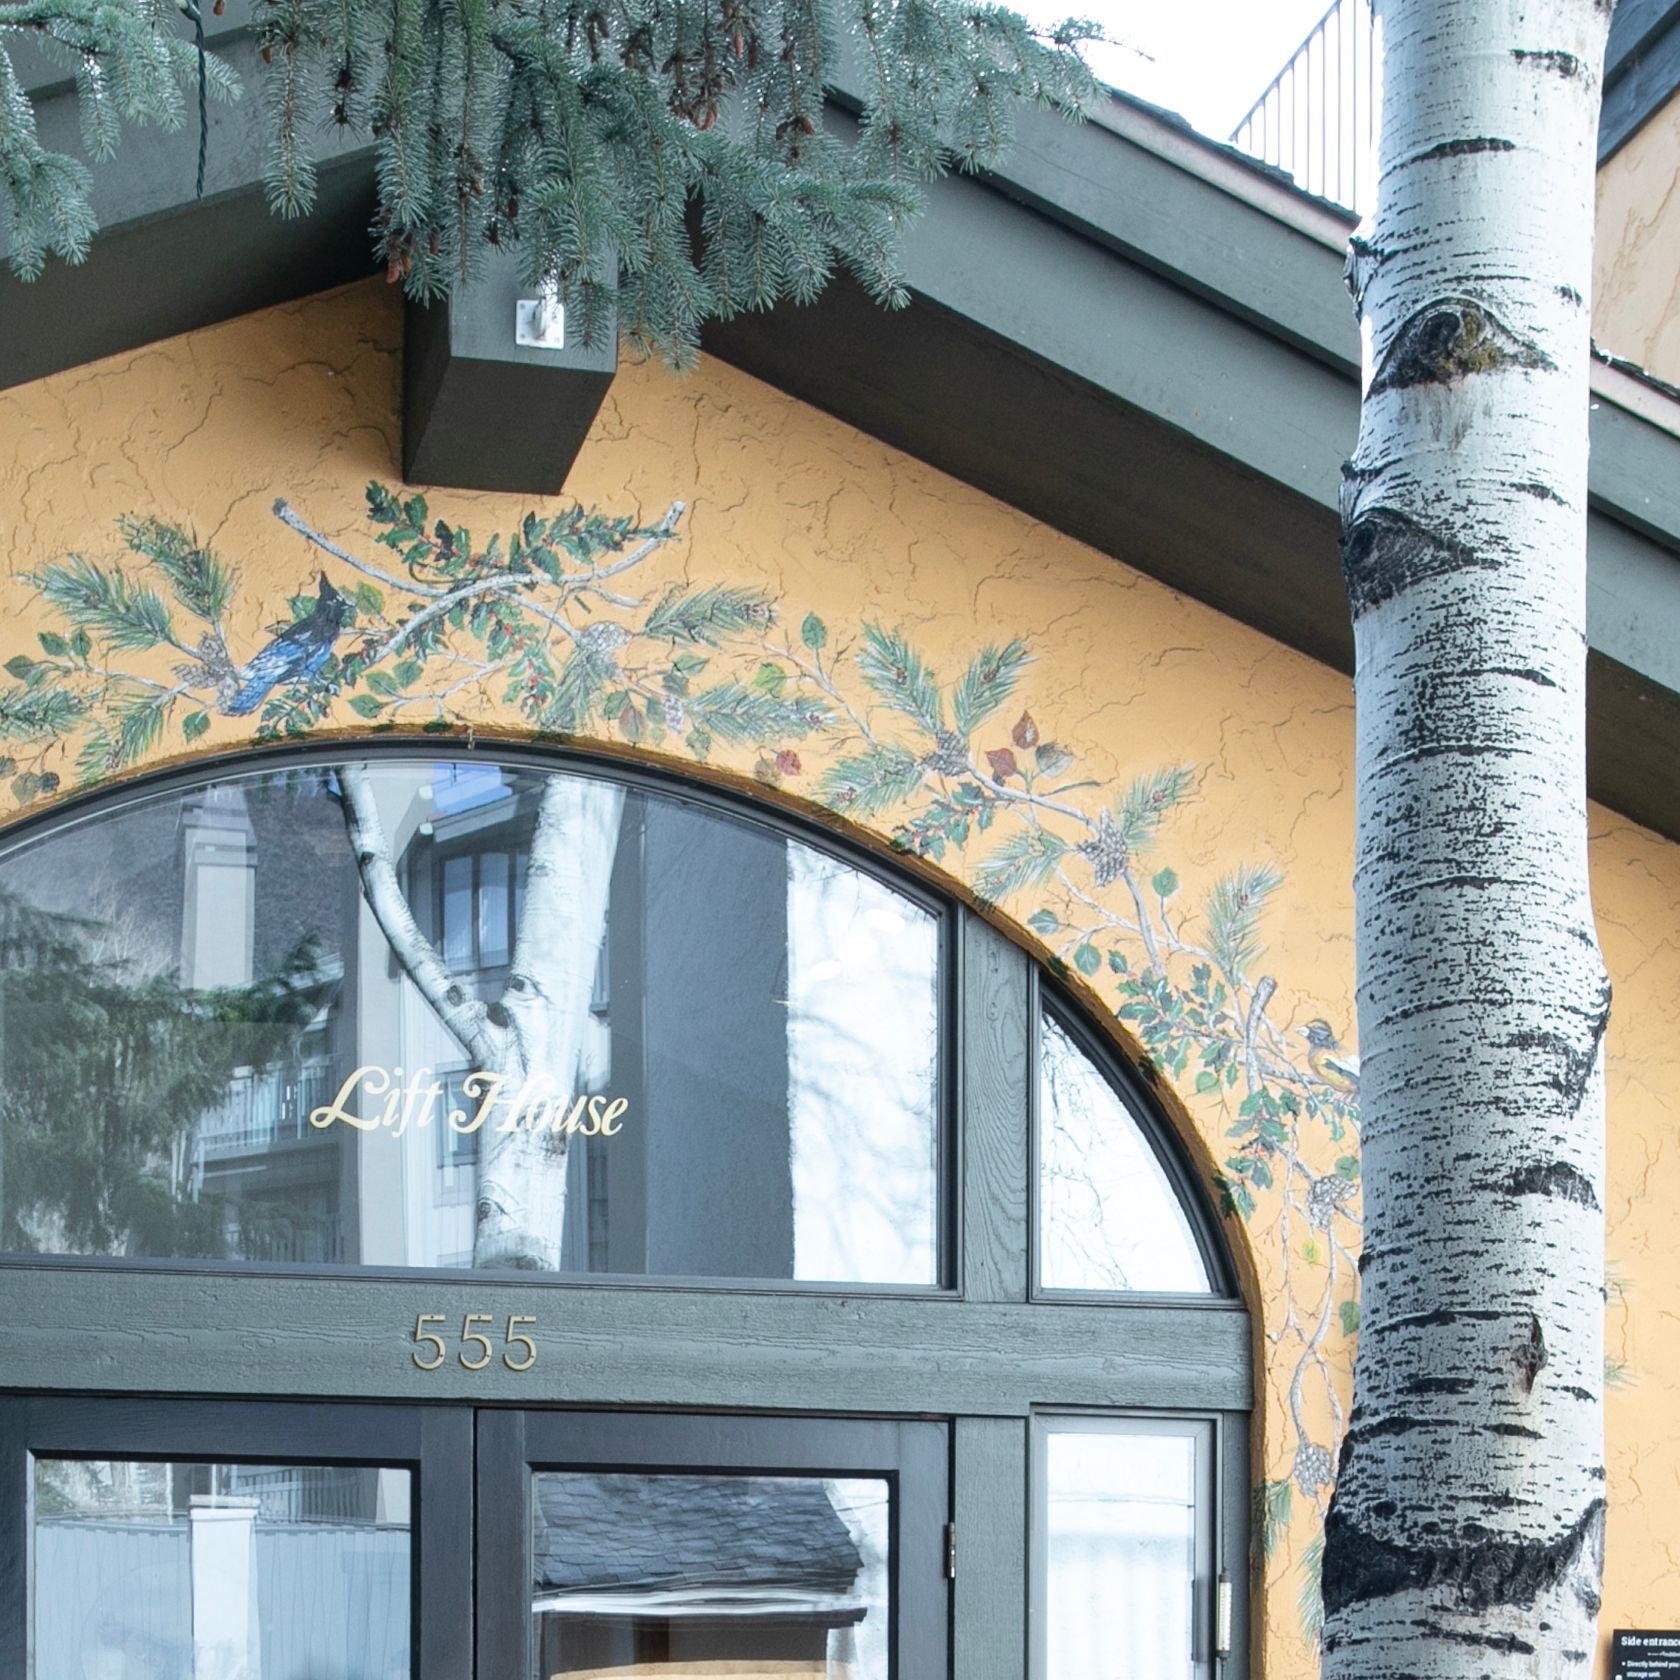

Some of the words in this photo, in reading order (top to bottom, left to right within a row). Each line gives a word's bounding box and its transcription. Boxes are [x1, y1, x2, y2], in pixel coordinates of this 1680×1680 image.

[310, 1066, 443, 1138] Lift
[448, 1071, 629, 1137] House
[411, 1314, 537, 1371] 555
[1621, 1635, 1641, 1647] Side
[1627, 1660, 1648, 1669] Directly
[1649, 1660, 1668, 1668] behind
[1668, 1662, 1679, 1670] you
